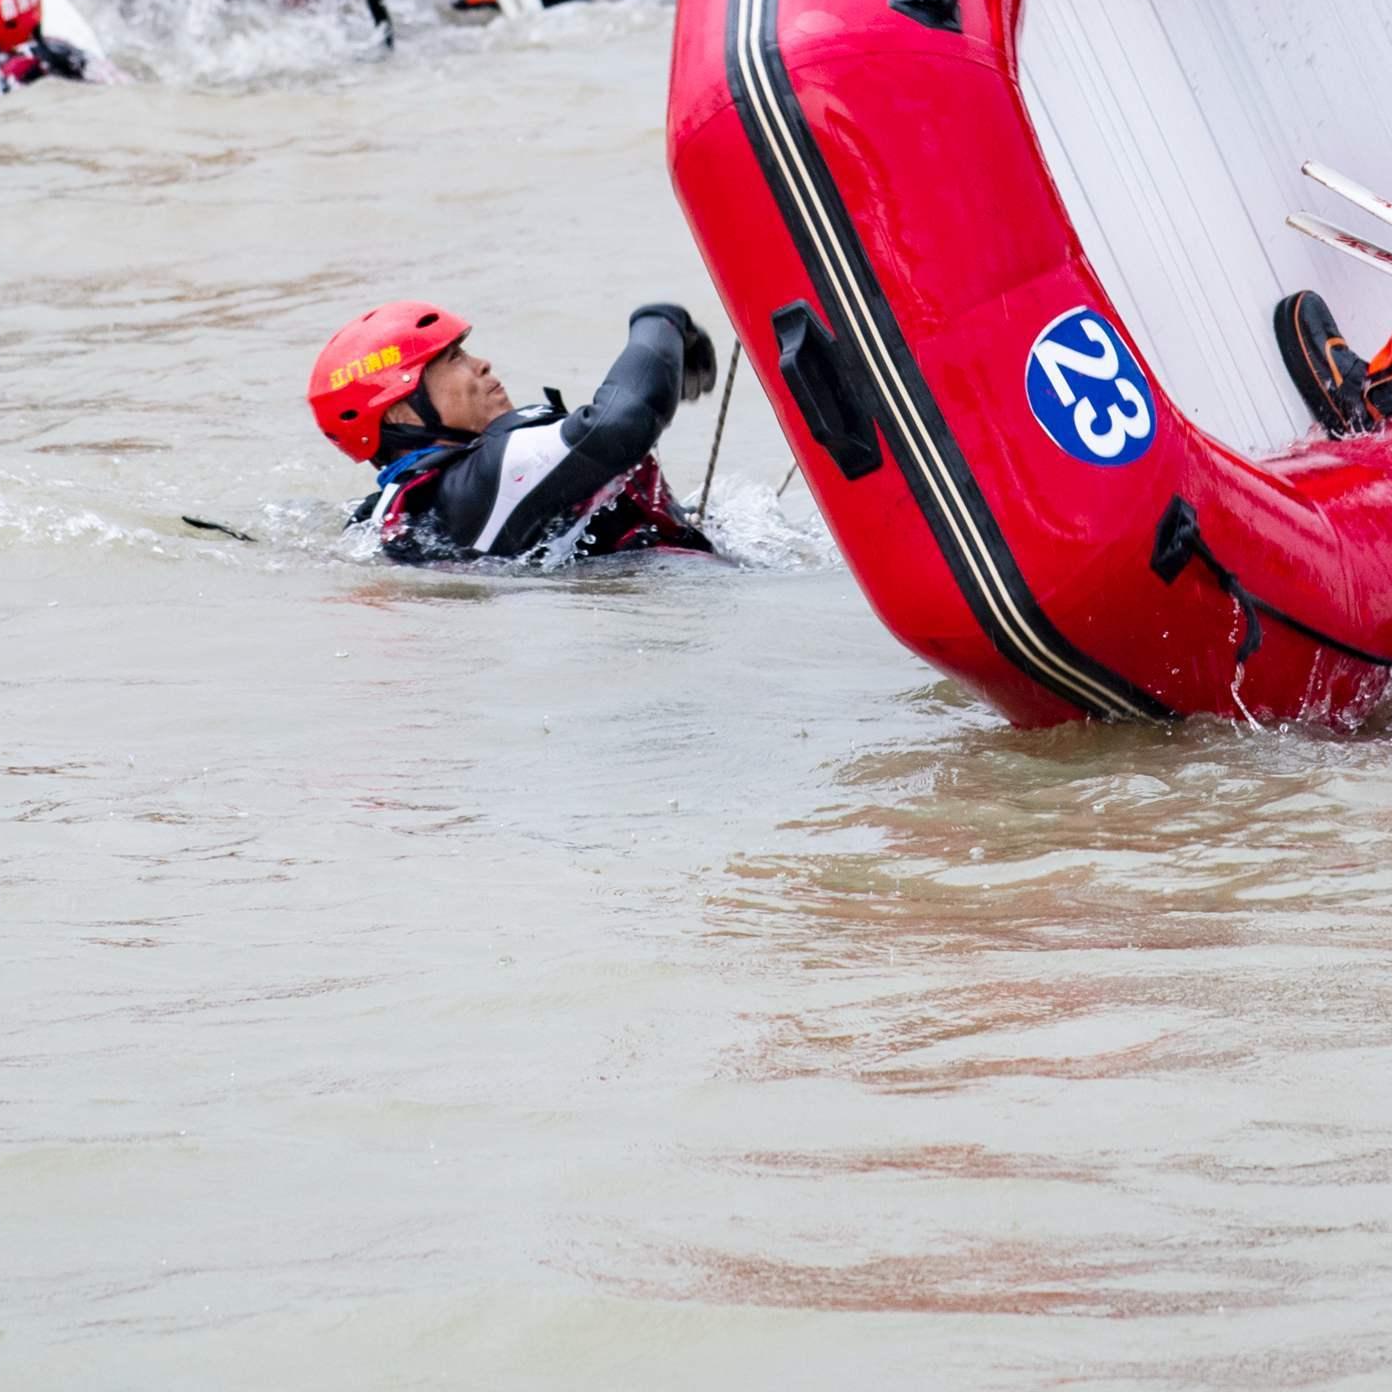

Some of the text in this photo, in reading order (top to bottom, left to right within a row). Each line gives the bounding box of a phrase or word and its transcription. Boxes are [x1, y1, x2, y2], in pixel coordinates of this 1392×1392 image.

[330, 344, 401, 391] 江门消防
[1033, 318, 1151, 458] 23
